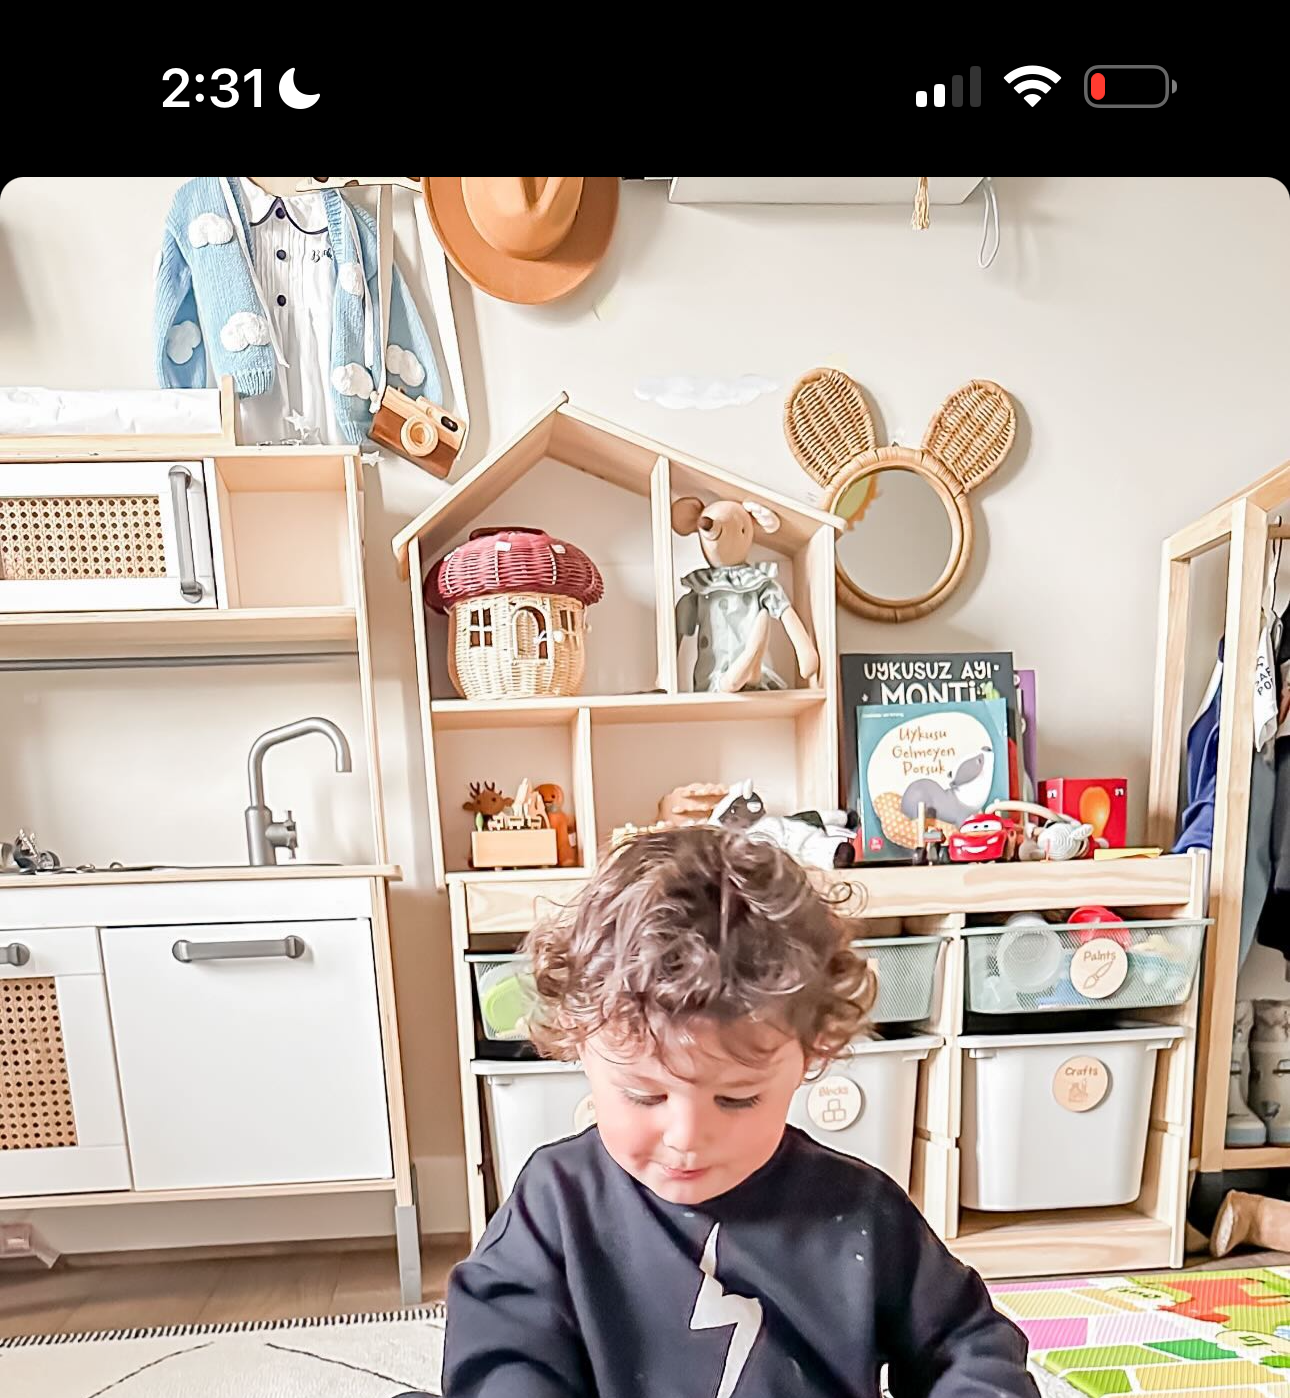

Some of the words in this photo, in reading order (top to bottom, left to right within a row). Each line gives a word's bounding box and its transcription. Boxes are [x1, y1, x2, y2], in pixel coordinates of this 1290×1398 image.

[863, 661, 952, 681] UYKUSUZ
[960, 661, 992, 680] AYI
[899, 725, 947, 744] Uykusu
[892, 745, 955, 762] Gelmeyen
[1083, 949, 1117, 962] Paints
[1064, 1065, 1098, 1076] Crafts
